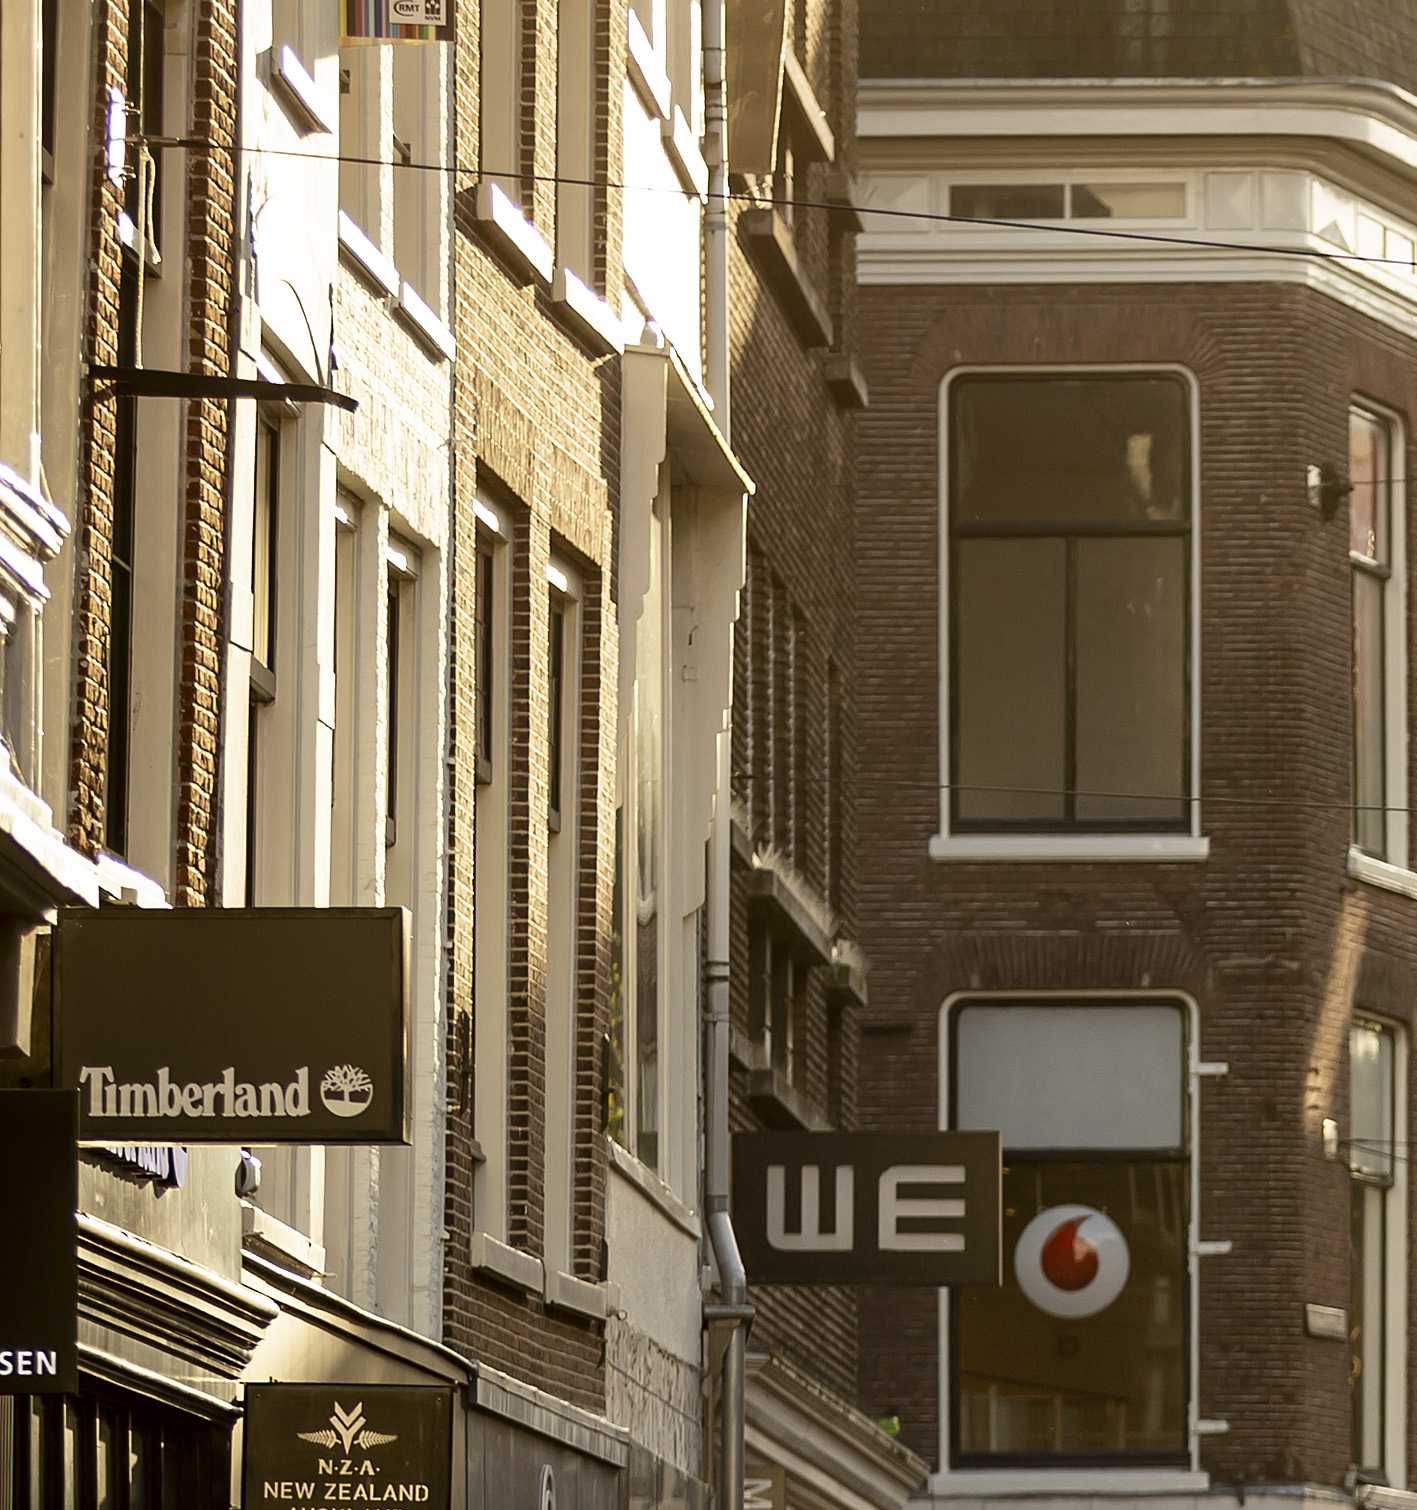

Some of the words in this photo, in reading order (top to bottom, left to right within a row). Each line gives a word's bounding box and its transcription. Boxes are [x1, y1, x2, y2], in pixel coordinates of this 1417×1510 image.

[79, 1066, 311, 1118] Timberland
[767, 1165, 965, 1250] WE
[0, 1351, 57, 1376] SEN
[264, 1481, 315, 1500] NEW
[324, 1483, 429, 1502] ZEALAND
